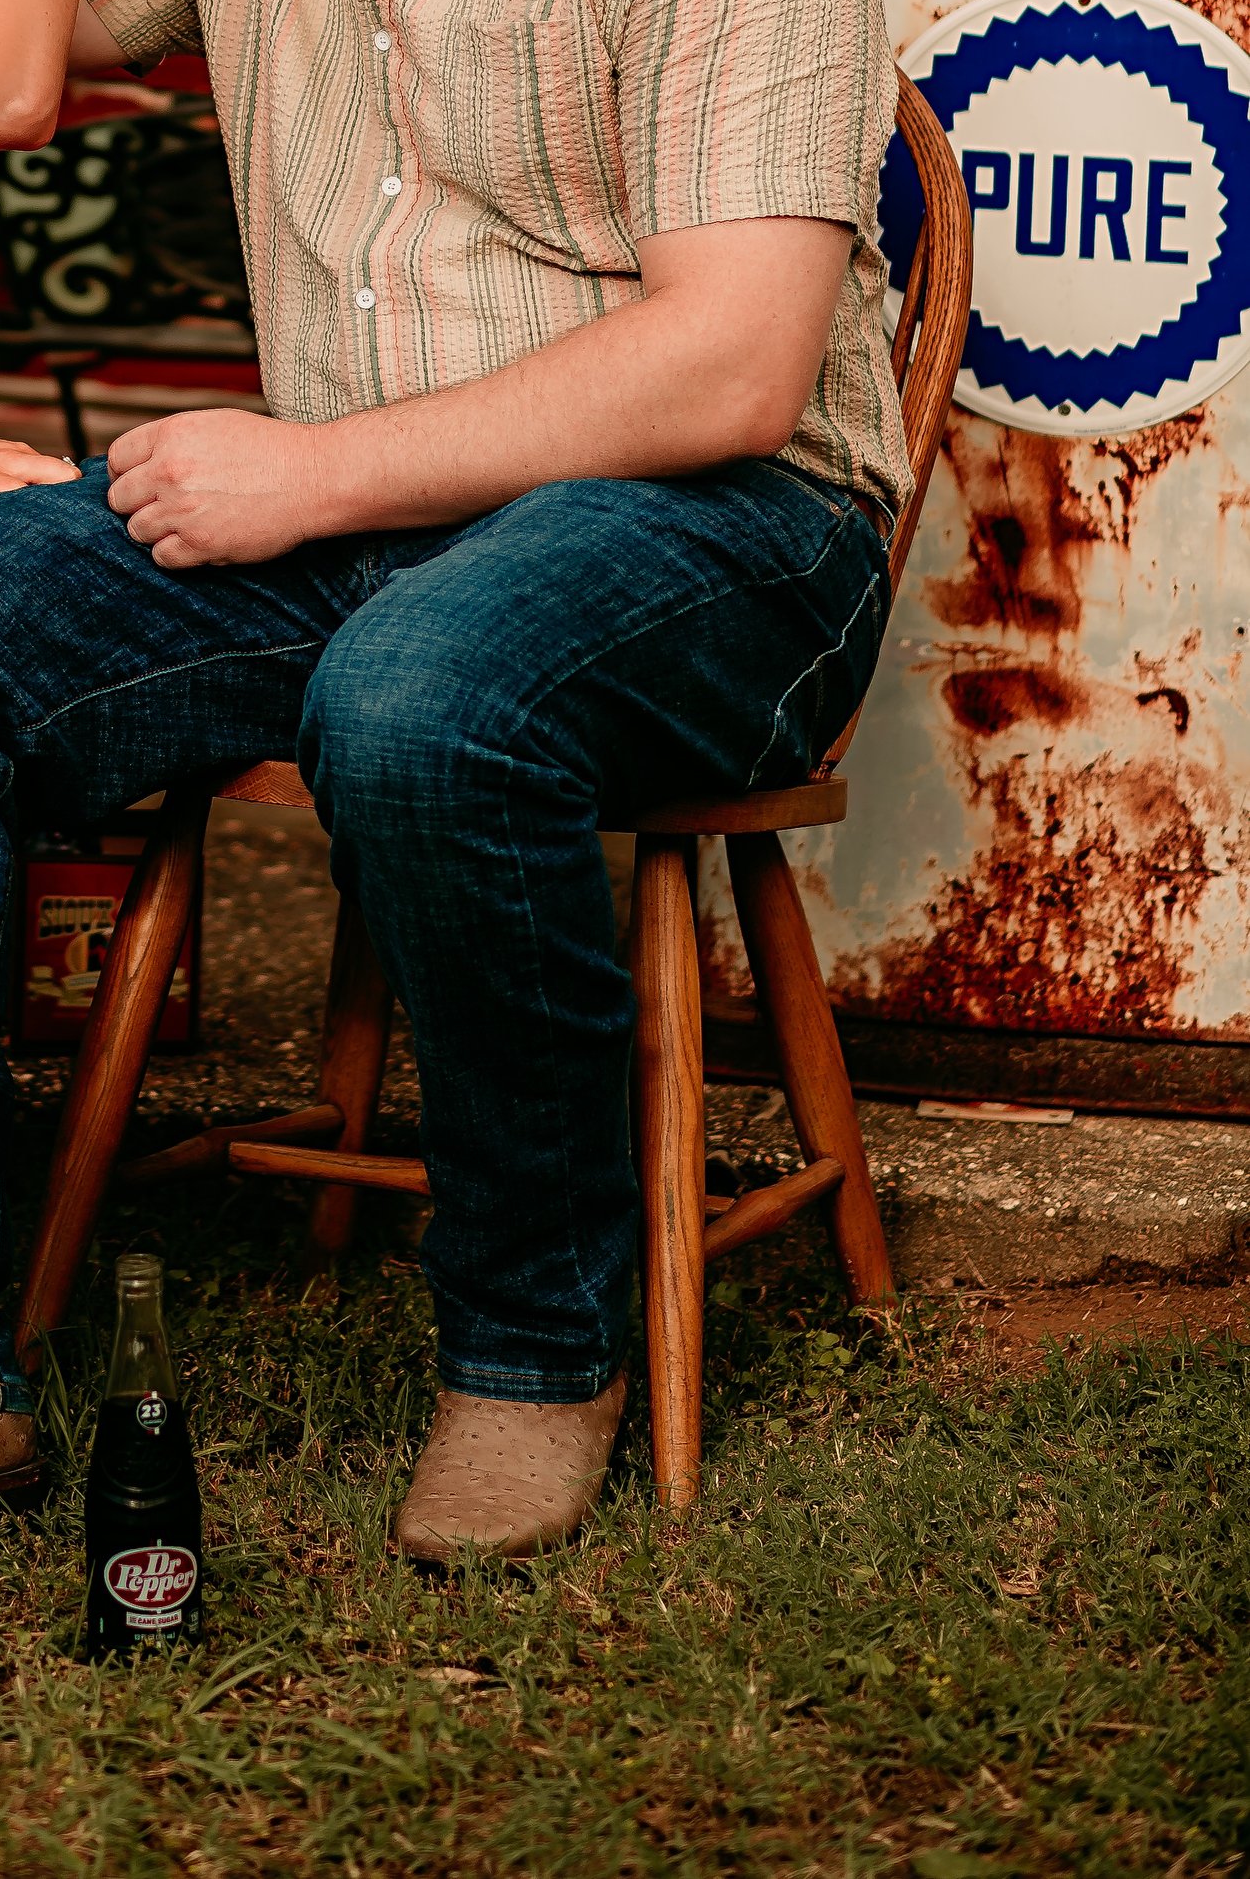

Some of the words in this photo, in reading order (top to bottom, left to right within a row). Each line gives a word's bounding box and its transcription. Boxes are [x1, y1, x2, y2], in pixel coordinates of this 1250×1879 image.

[961, 148, 1193, 265] PURE
[141, 1403, 160, 1418] 23
[142, 1552, 181, 1576] Dr
[114, 1563, 194, 1602] Pepper
